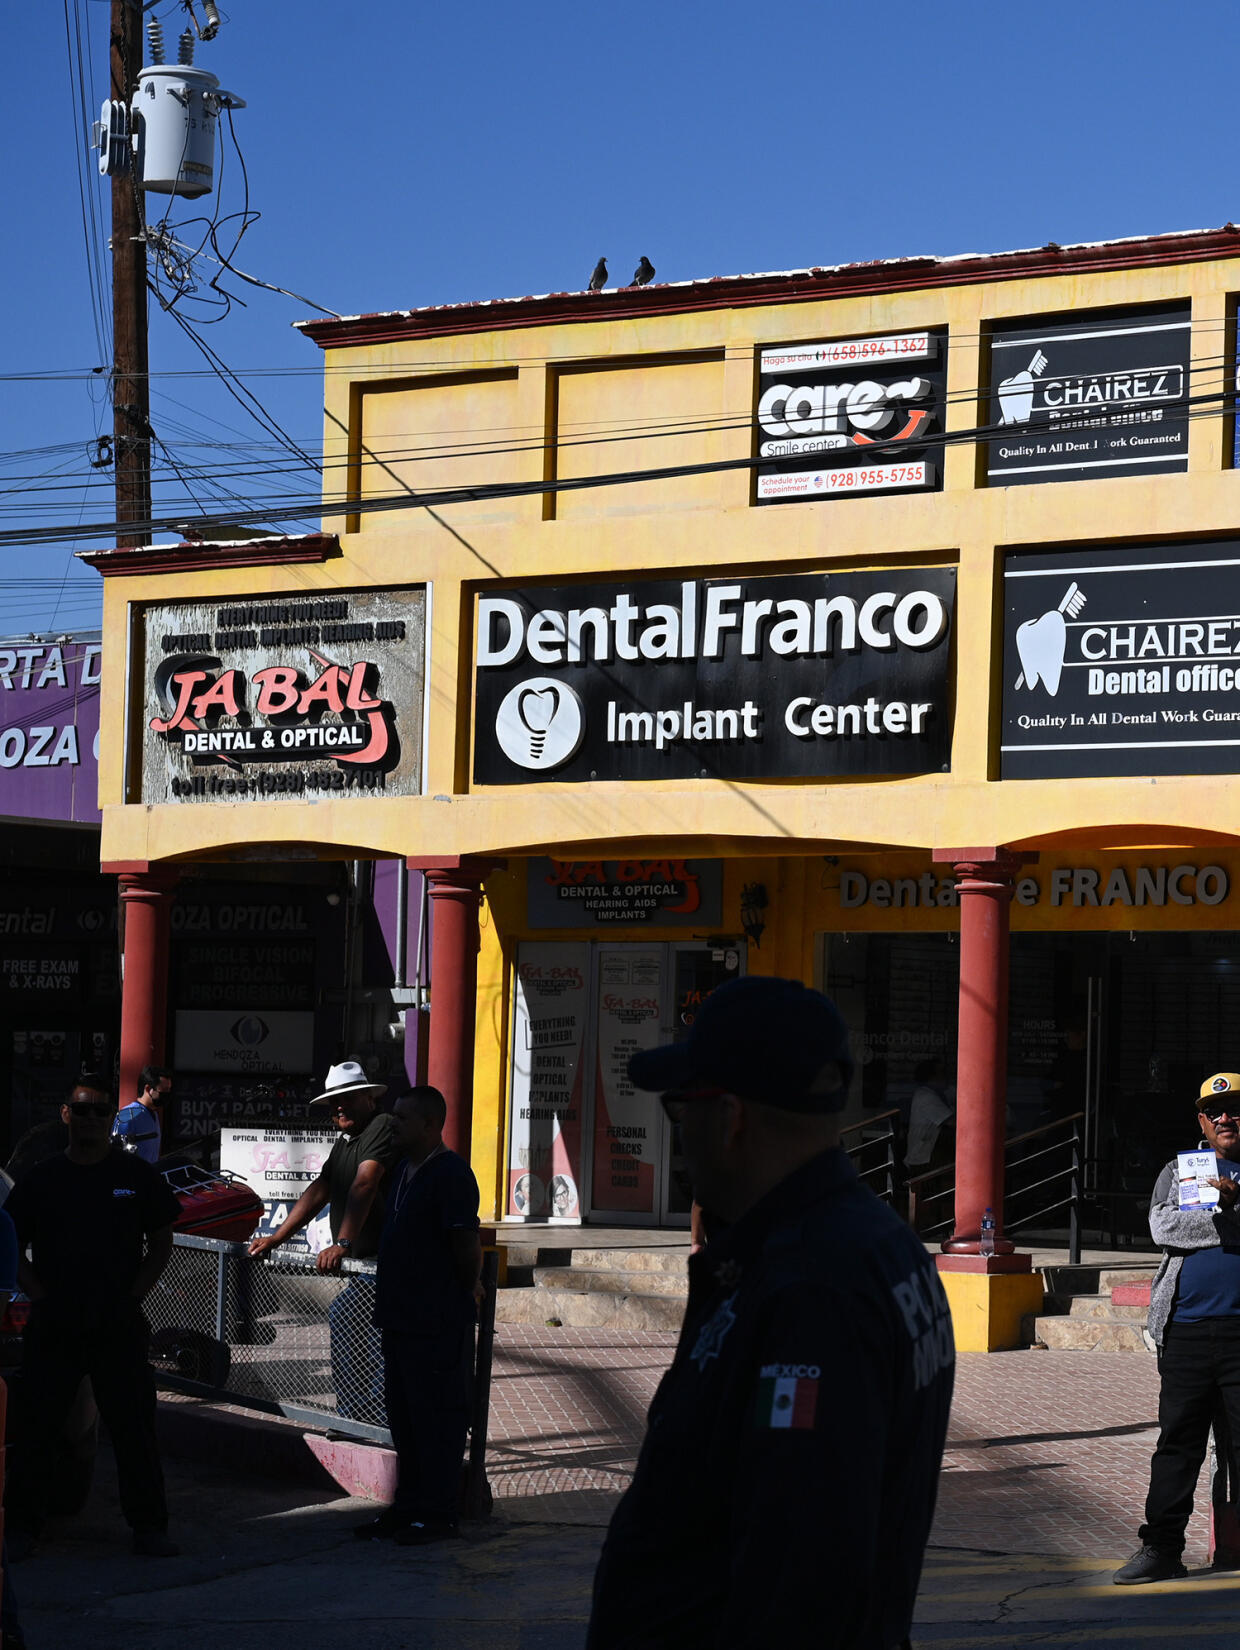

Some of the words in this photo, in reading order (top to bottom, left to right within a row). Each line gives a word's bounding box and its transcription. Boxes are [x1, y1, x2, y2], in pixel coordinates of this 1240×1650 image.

[763, 356, 786, 367] Haga
[786, 355, 797, 363] su
[797, 353, 813, 363] cita
[1043, 371, 1169, 406] CHAIREZ
[767, 440, 799, 456] Smile
[802, 438, 841, 453] center
[999, 446, 1035, 458] Quality
[1036, 445, 1047, 455] In
[1048, 443, 1063, 454] All
[1103, 436, 1128, 448] ork
[1129, 432, 1182, 447] Guaranted
[761, 476, 794, 486] Schedule
[795, 476, 811, 487] your
[825, 472, 859, 489] (928)
[860, 466, 923, 485] 955-5755
[763, 484, 808, 496] appointment
[217, 605, 288, 626] EVERYTHING
[288, 603, 314, 622] YOU
[312, 600, 349, 619] NEED!
[476, 581, 944, 667] DentalFranco
[161, 633, 211, 652] OPTICAL
[214, 629, 257, 650] DENTAL
[259, 625, 320, 646] IMPLANTS
[321, 622, 374, 643] HEARING
[375, 620, 406, 640] AIDS
[1088, 666, 1170, 695] Dental
[150, 671, 240, 732] JA
[607, 700, 759, 749] Implant
[785, 697, 929, 736] Center
[1017, 712, 1067, 729] Quality
[1070, 713, 1084, 726] In
[1087, 712, 1107, 726] All
[1111, 710, 1157, 725] Dental
[1160, 709, 1199, 723] Work
[184, 731, 257, 751] DENTAL
[261, 731, 276, 748] &
[280, 726, 363, 748] OPTICAL
[172, 776, 206, 797] toll
[560, 886, 609, 897] DENTAL
[612, 886, 622, 896] &
[624, 884, 678, 896] OPTICAL
[839, 871, 960, 907] Denta
[1050, 865, 1229, 907] FRANCO
[585, 899, 629, 909] HEARING
[633, 899, 657, 908] AIDS
[218, 904, 309, 931] OPTICAL
[597, 910, 647, 919] IMPLANTS
[188, 946, 250, 964] SINGLE
[254, 946, 314, 964] VISION
[3, 959, 39, 974] FREE
[41, 959, 80, 974] EXAM
[212, 965, 286, 983] BIFOCAL
[8, 975, 20, 989] &
[23, 975, 72, 990] X-RAYS
[191, 984, 310, 1001] PROGRESSIVE
[529, 1015, 577, 1032] EVERYTHING
[1023, 1019, 1057, 1030] HOURS
[533, 1032, 549, 1045] YOU
[549, 1030, 573, 1044] NEED!
[899, 1029, 949, 1047] Dental
[213, 1049, 260, 1061] MENDOZA
[535, 1056, 566, 1068] DENTAL
[241, 1060, 285, 1073] OPTICAL
[533, 1073, 568, 1085] OPTICAL
[529, 1090, 570, 1103] IMPLANTS
[180, 1100, 217, 1116] BUY
[220, 1100, 228, 1115] 1
[519, 1108, 555, 1121] HEARING
[179, 1119, 222, 1136] 2ND
[306, 1129, 319, 1137] YOU
[606, 1125, 647, 1139] PERSONAL
[263, 1135, 287, 1143] DENTAL
[291, 1136, 323, 1144] IMPLANTS
[610, 1143, 642, 1155] CHECKS
[611, 1159, 640, 1171] CREDIT
[265, 1171, 299, 1181] DENTAL
[301, 1172, 309, 1181] &
[611, 1175, 639, 1188] CARDS
